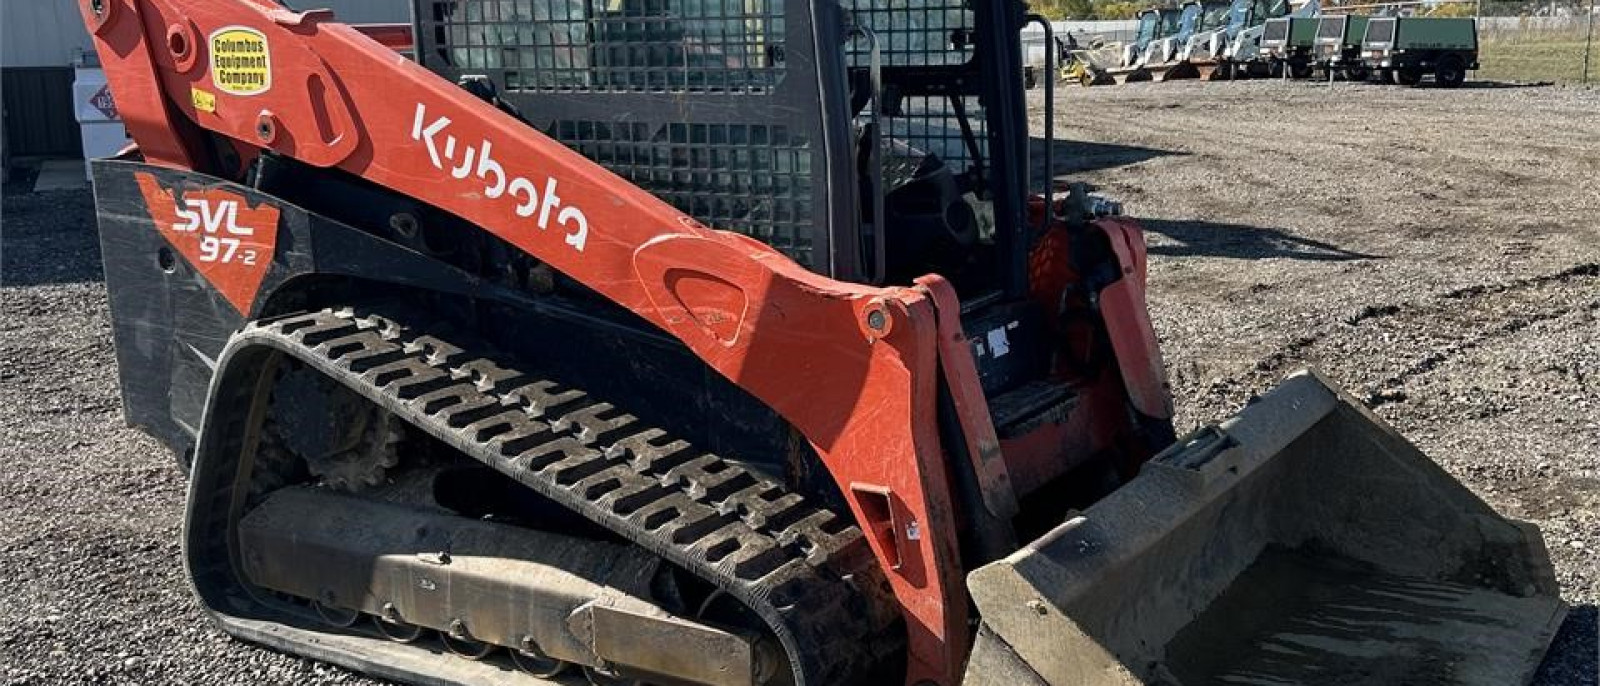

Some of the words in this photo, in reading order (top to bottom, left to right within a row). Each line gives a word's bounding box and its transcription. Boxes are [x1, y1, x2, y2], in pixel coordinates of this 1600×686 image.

[214, 38, 264, 53] Columbus
[214, 54, 266, 70] Equipment
[219, 69, 265, 86] Company
[412, 102, 588, 252] Kubota
[172, 198, 254, 236] SVL
[200, 235, 257, 266] 97-2
